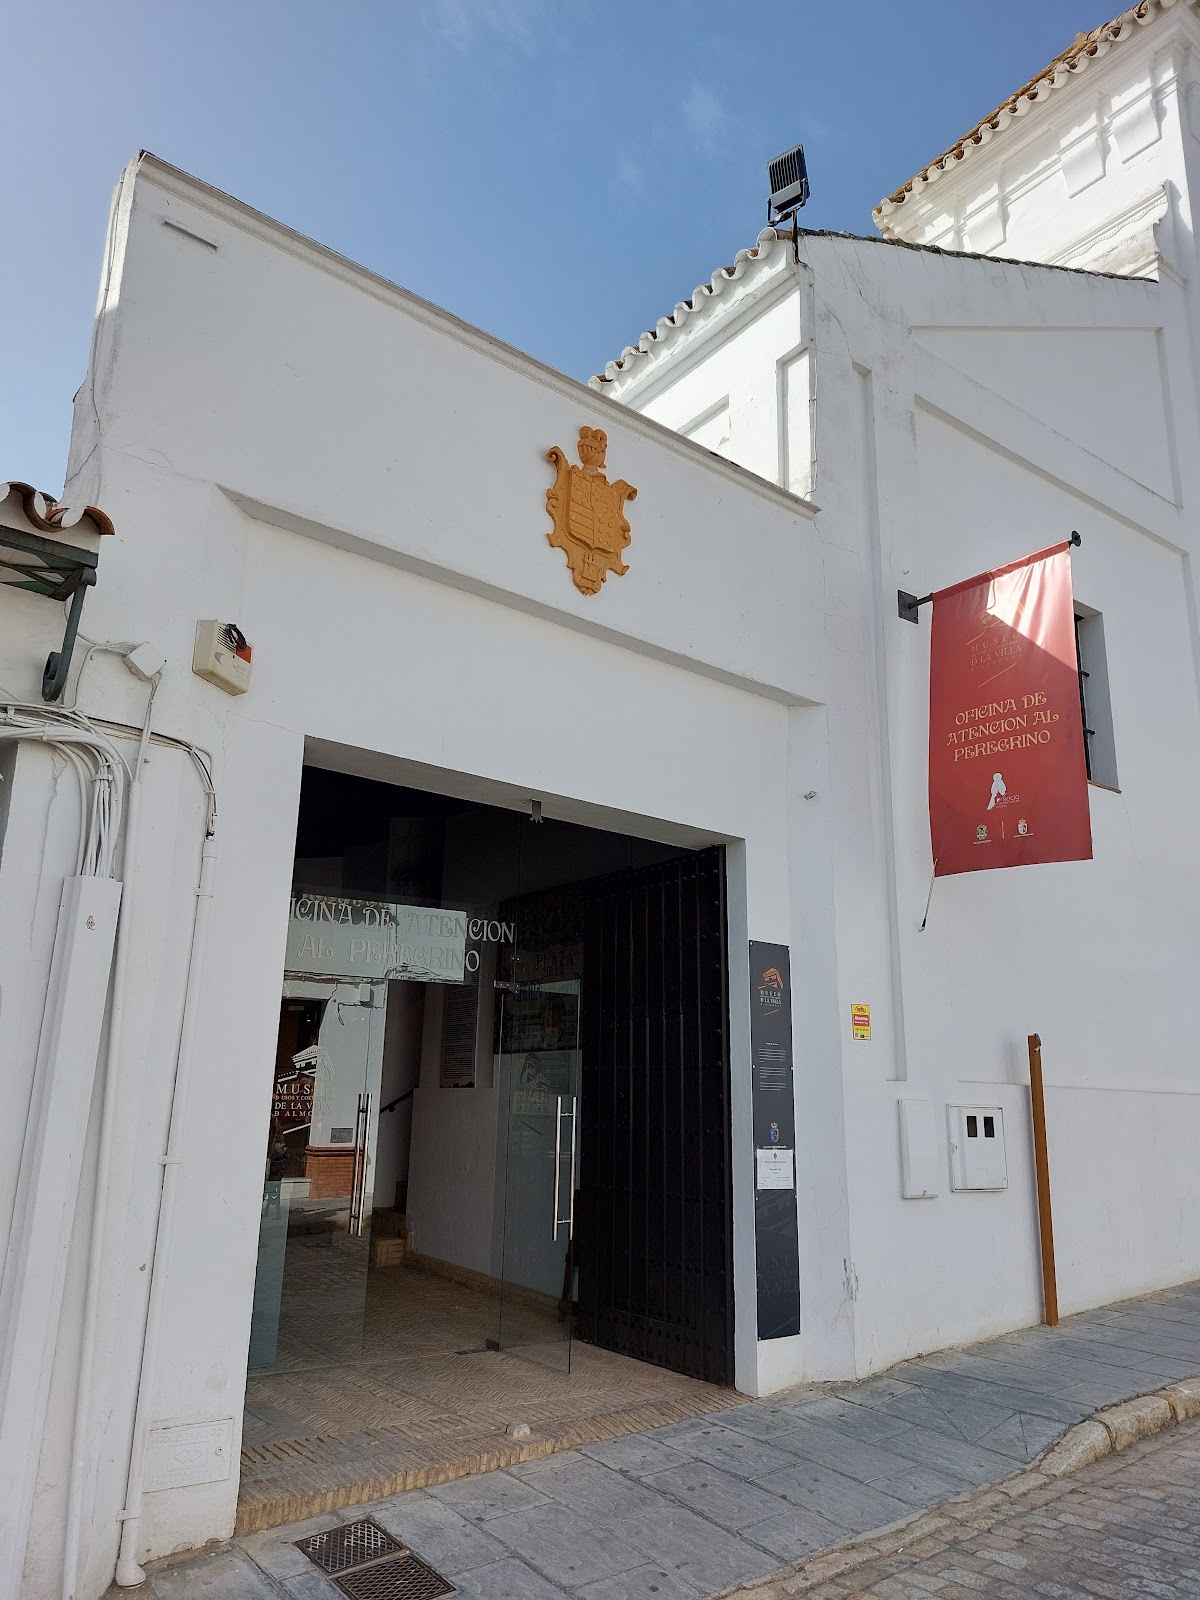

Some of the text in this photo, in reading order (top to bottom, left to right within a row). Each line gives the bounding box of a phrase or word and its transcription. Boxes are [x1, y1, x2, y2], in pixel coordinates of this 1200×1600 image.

[971, 631, 1020, 653] MUSEO
[980, 654, 992, 664] LA
[994, 645, 1022, 658] VILLA
[955, 691, 1047, 725] OFICINA DE
[946, 709, 1060, 746] ATENCION AL
[953, 729, 1051, 762] PEREGRINO
[363, 904, 396, 931] DE
[404, 912, 516, 944] ATENCION
[297, 934, 481, 972] AL PEREGRINO
[274, 1101, 287, 1110] DE
[290, 1101, 303, 1110] LA
[275, 1083, 333, 1095] MUSO
